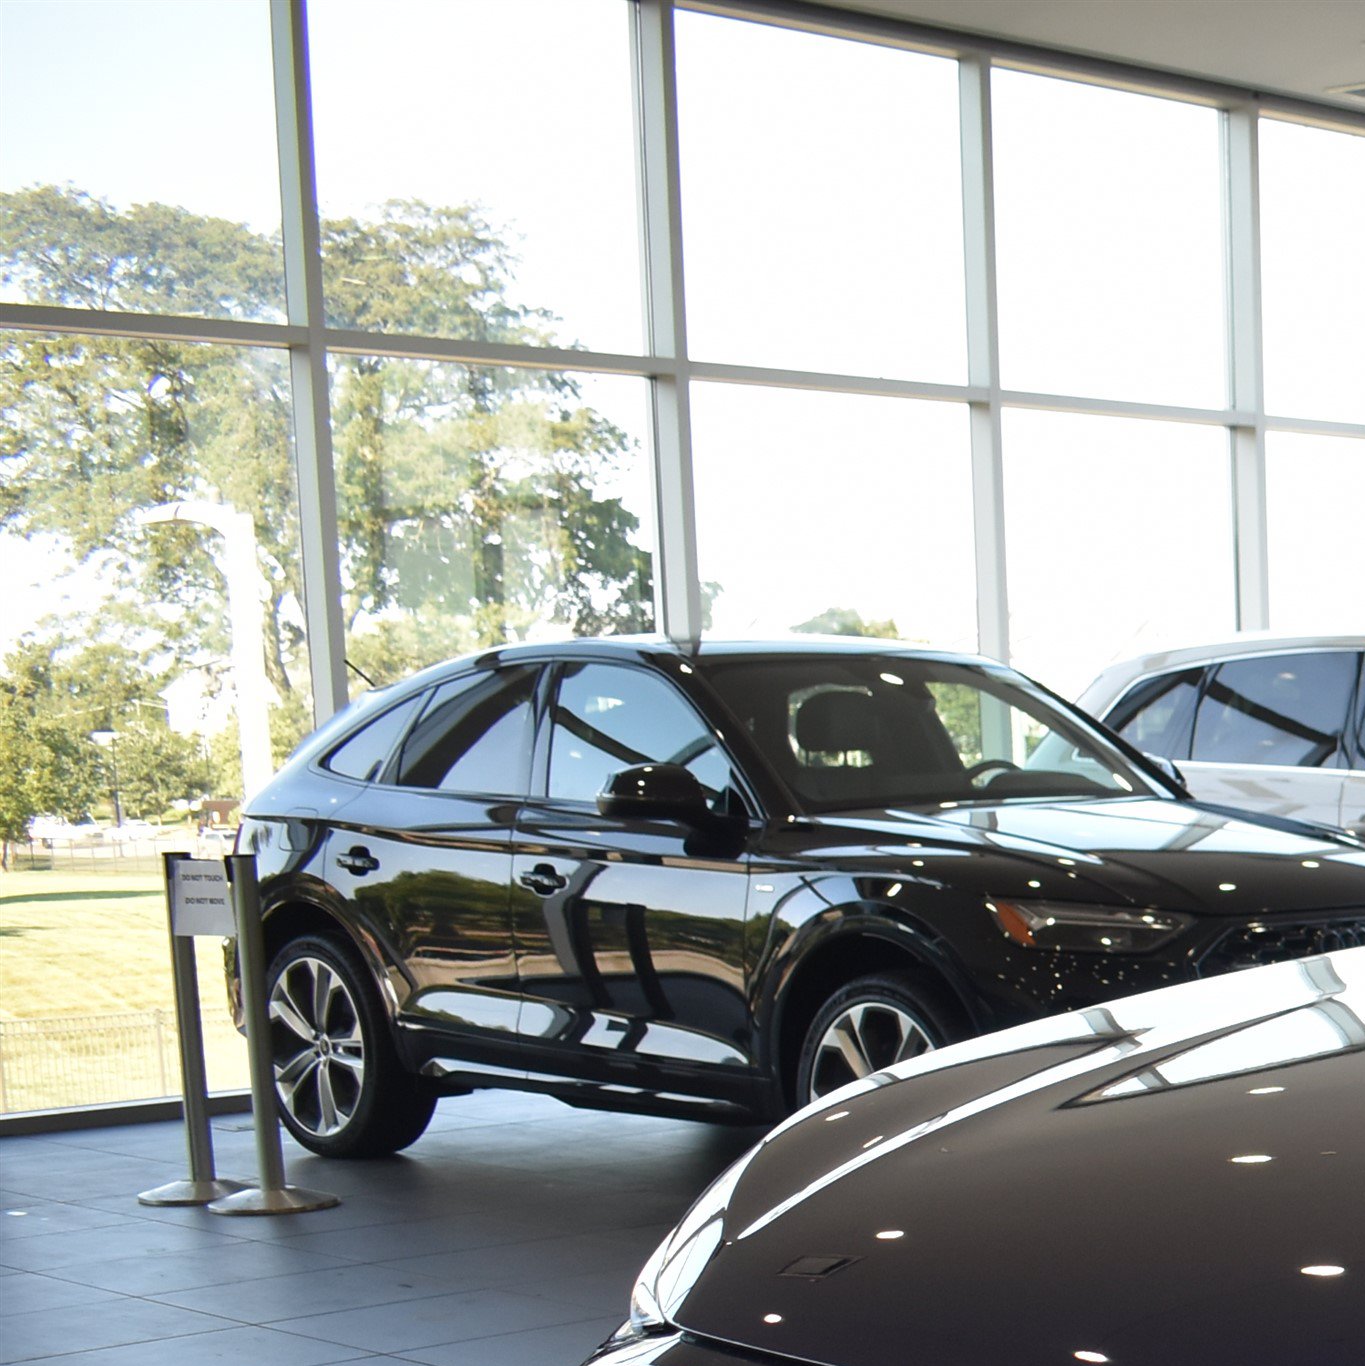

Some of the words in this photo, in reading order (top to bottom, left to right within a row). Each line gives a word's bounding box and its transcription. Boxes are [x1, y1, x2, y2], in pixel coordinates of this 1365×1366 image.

[204, 874, 223, 882] TOUCH
[185, 897, 195, 905] DO
[196, 897, 208, 905] NOT
[209, 897, 225, 905] MOVE
